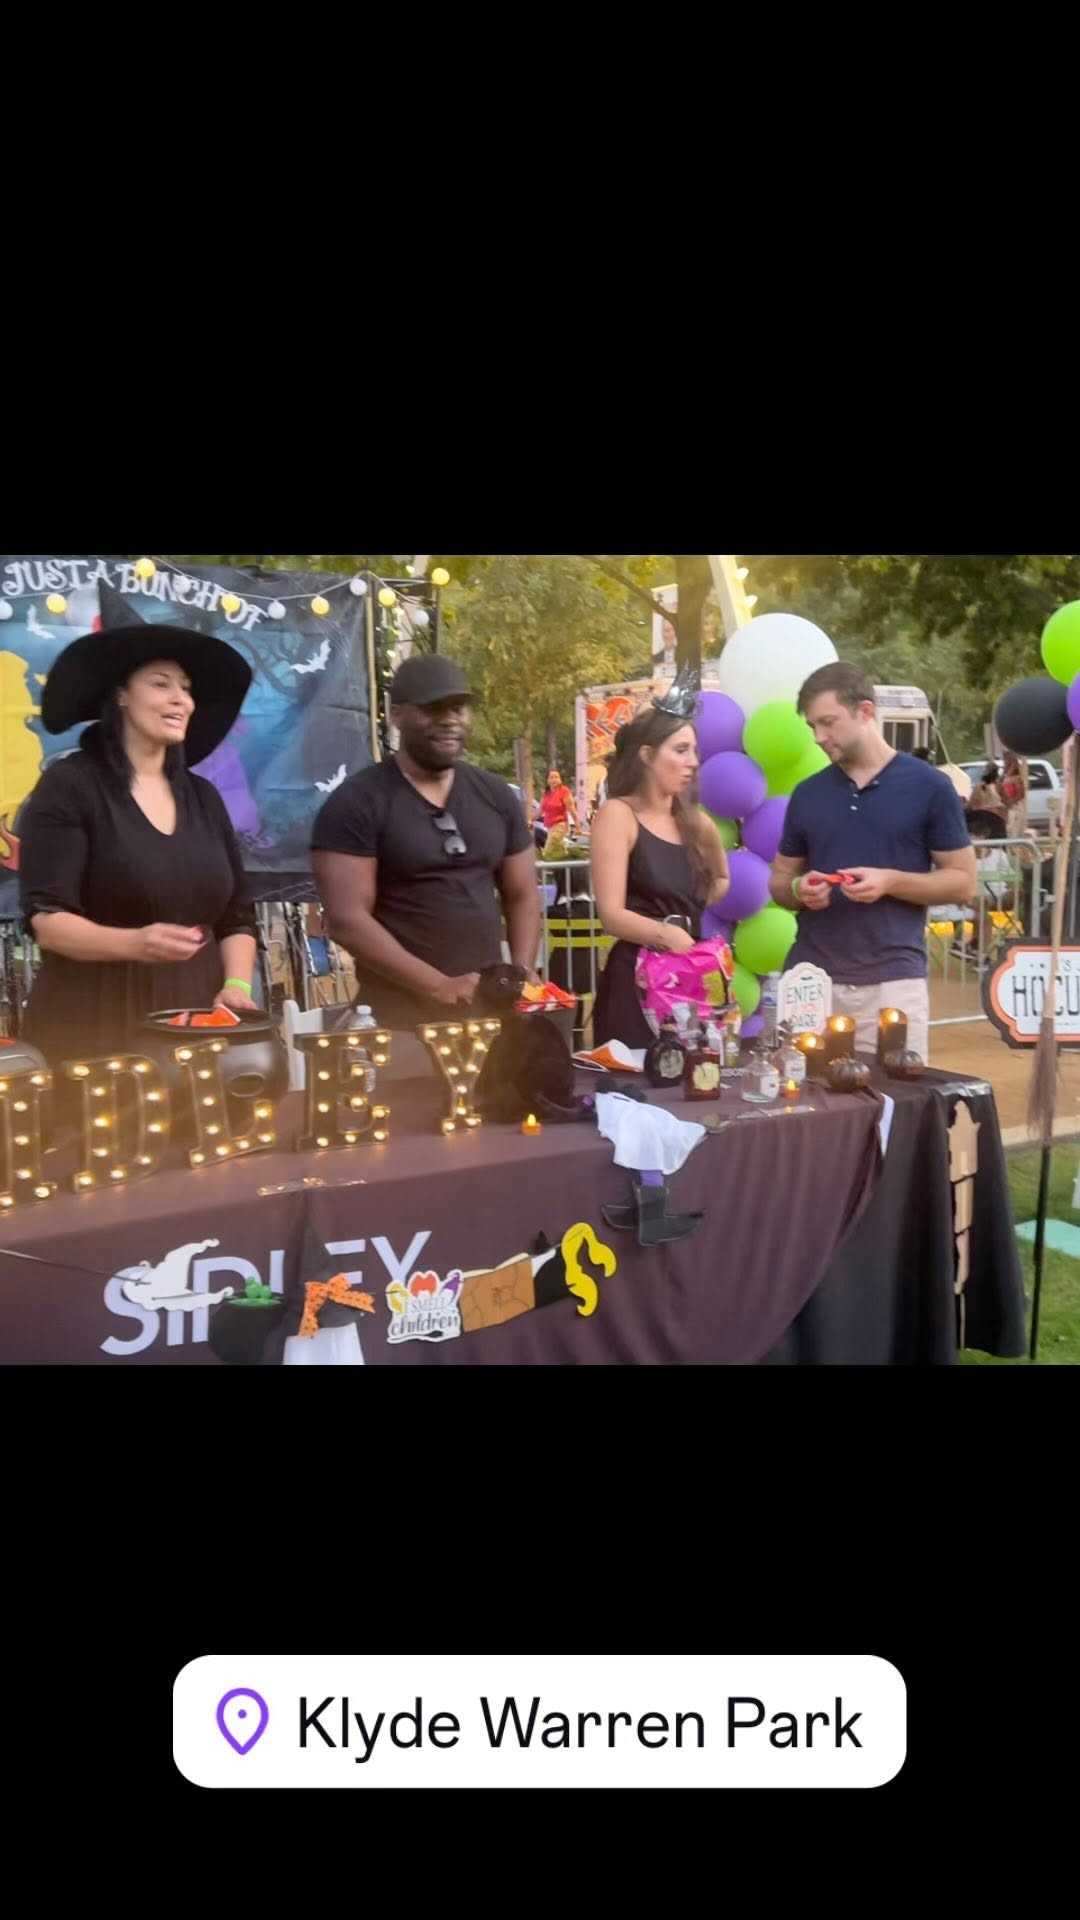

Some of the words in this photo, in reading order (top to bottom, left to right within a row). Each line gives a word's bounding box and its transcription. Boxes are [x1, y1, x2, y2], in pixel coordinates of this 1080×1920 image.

[2, 559, 90, 597] JUST
[87, 558, 115, 589] A
[115, 563, 222, 612] BUNCH
[391, 1308, 459, 1336] children
